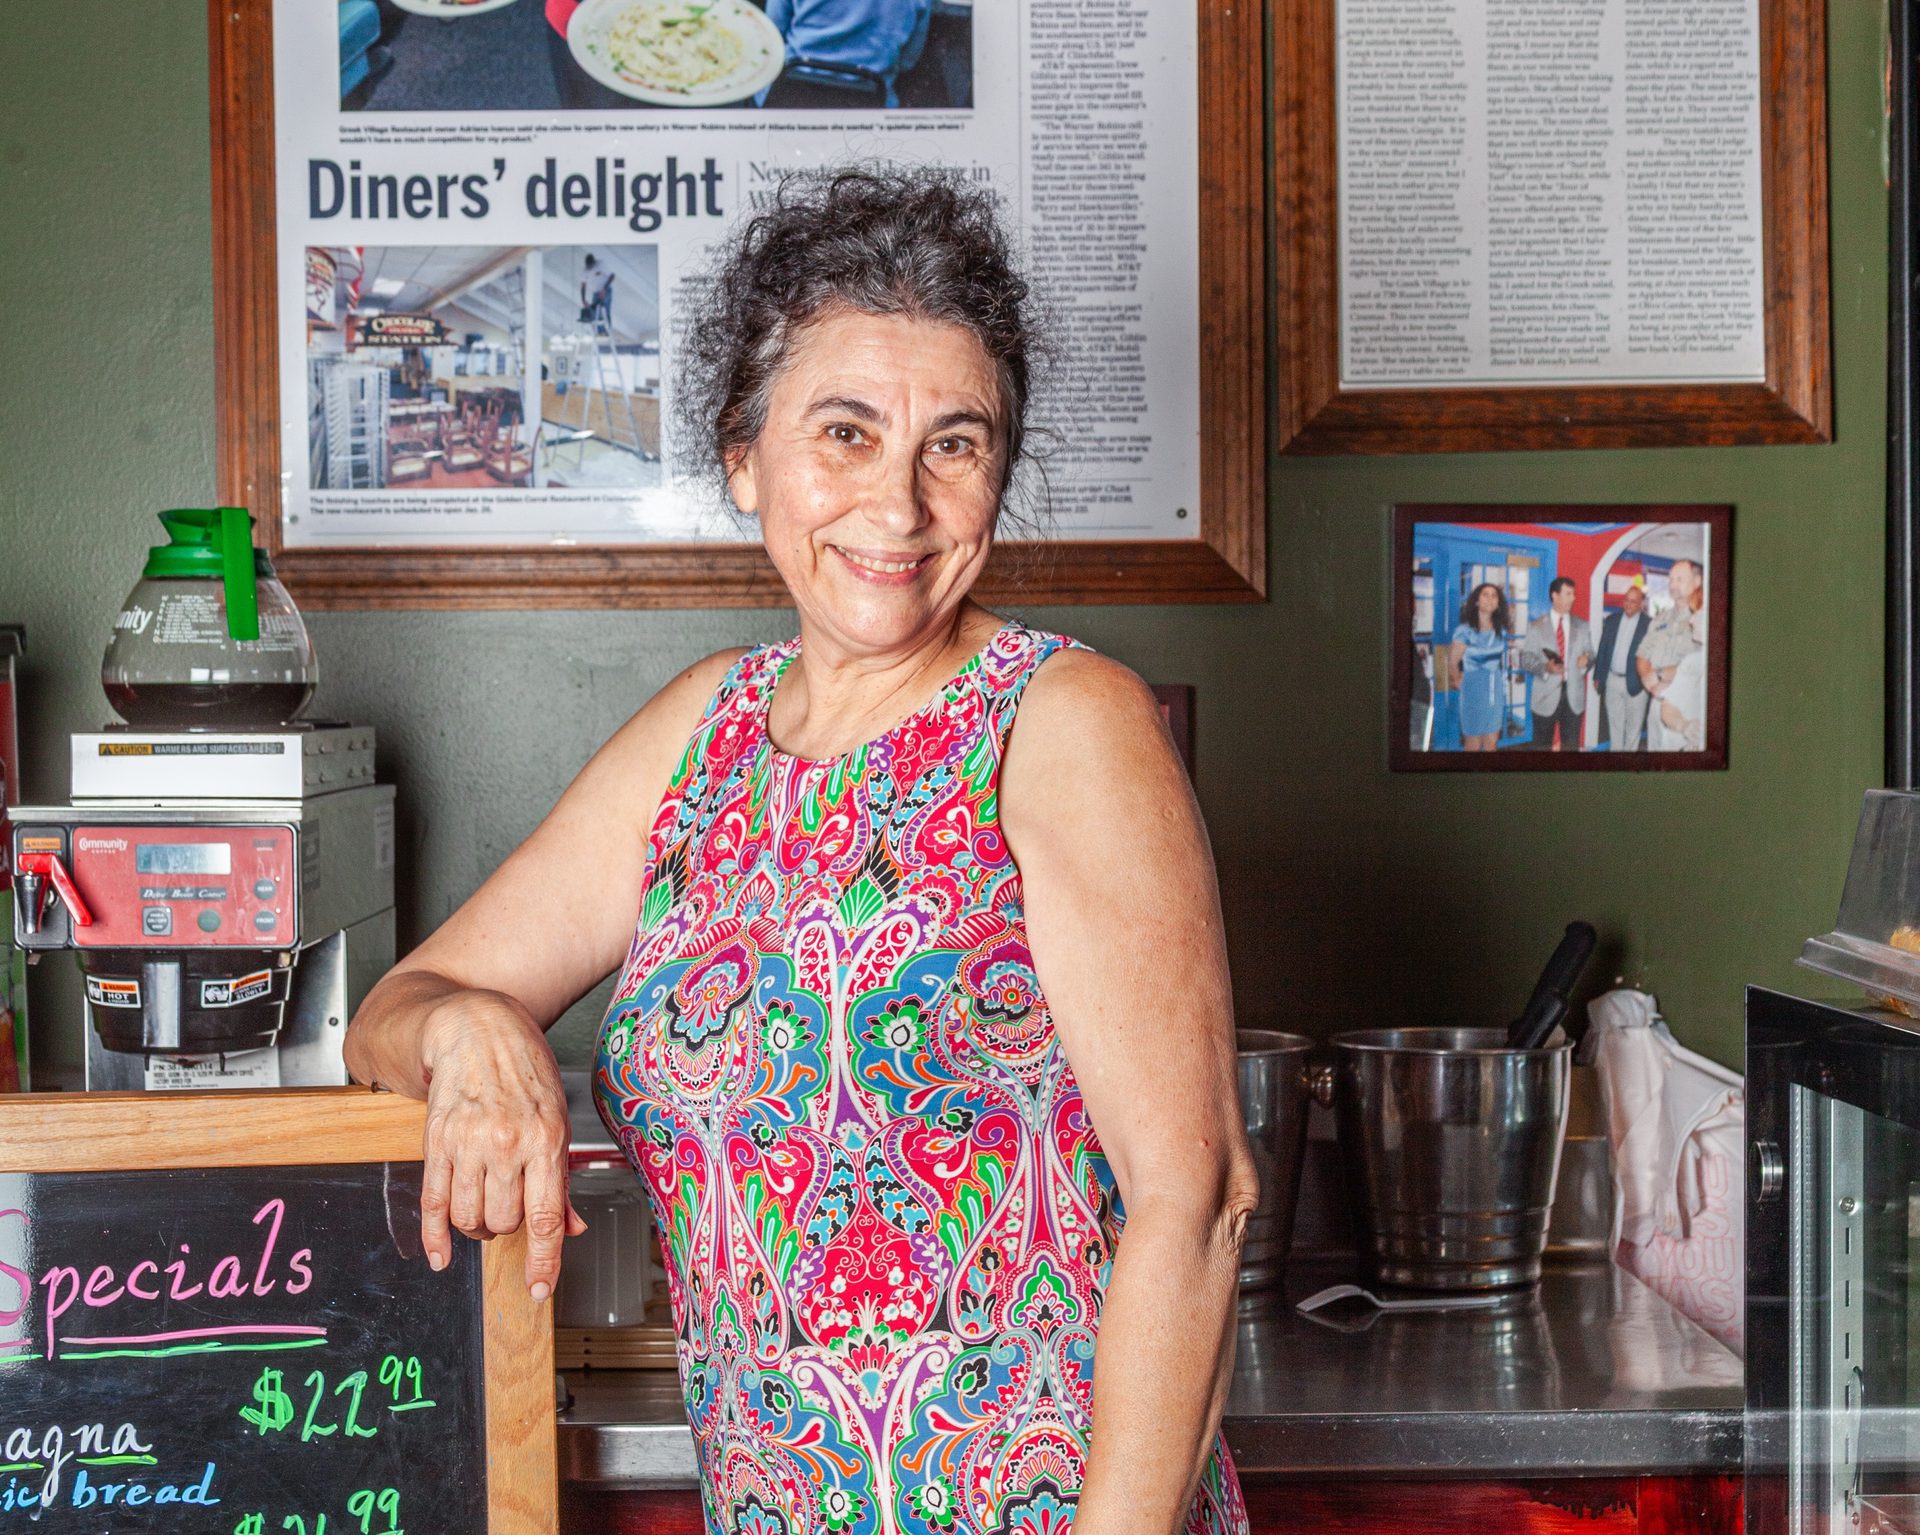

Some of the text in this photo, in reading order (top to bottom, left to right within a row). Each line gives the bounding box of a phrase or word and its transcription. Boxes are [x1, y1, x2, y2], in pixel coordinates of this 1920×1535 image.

[363, 125, 389, 134] Village
[672, 123, 698, 131] Warner
[701, 123, 726, 131] Robins
[729, 123, 756, 131] instead
[769, 123, 796, 131] Atlanta
[427, 135, 474, 144] competition
[476, 134, 486, 142] for
[488, 136, 500, 144] my
[308, 157, 723, 232] Diners’ delight
[481, 495, 494, 503] the
[113, 745, 149, 754] CAUTION
[192, 744, 207, 753] AND
[209, 744, 247, 752] SURFACES
[79, 837, 128, 852] Community
[108, 992, 129, 1000] HOT
[0, 1198, 313, 1361] Specials
[0, 1422, 154, 1508] agna
[0, 1461, 221, 1512] ic bread
